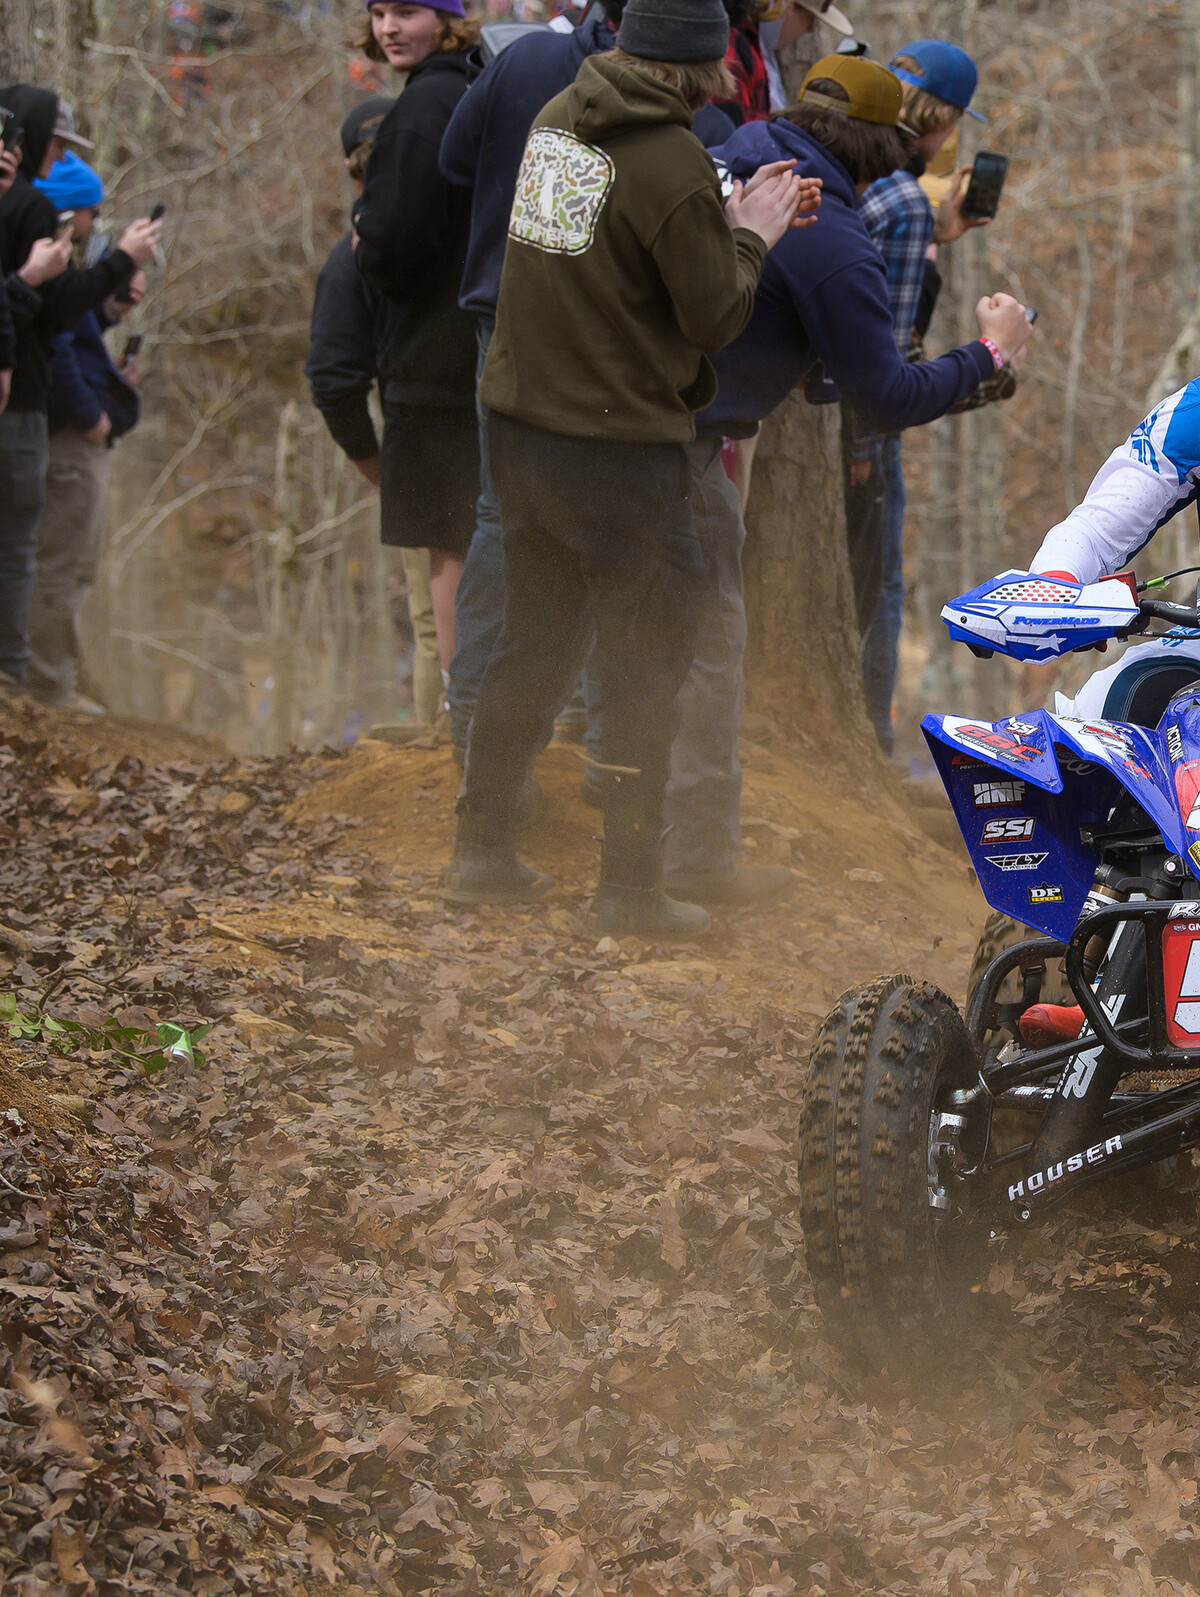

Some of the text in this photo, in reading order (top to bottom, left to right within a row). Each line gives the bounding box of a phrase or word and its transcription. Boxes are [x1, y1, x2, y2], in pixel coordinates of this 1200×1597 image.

[1007, 721, 1038, 735] SSI
[973, 781, 1026, 805] HMF
[983, 818, 1034, 839] SSI
[1030, 887, 1061, 897] DP
[1008, 1134, 1123, 1201] HOUSER
